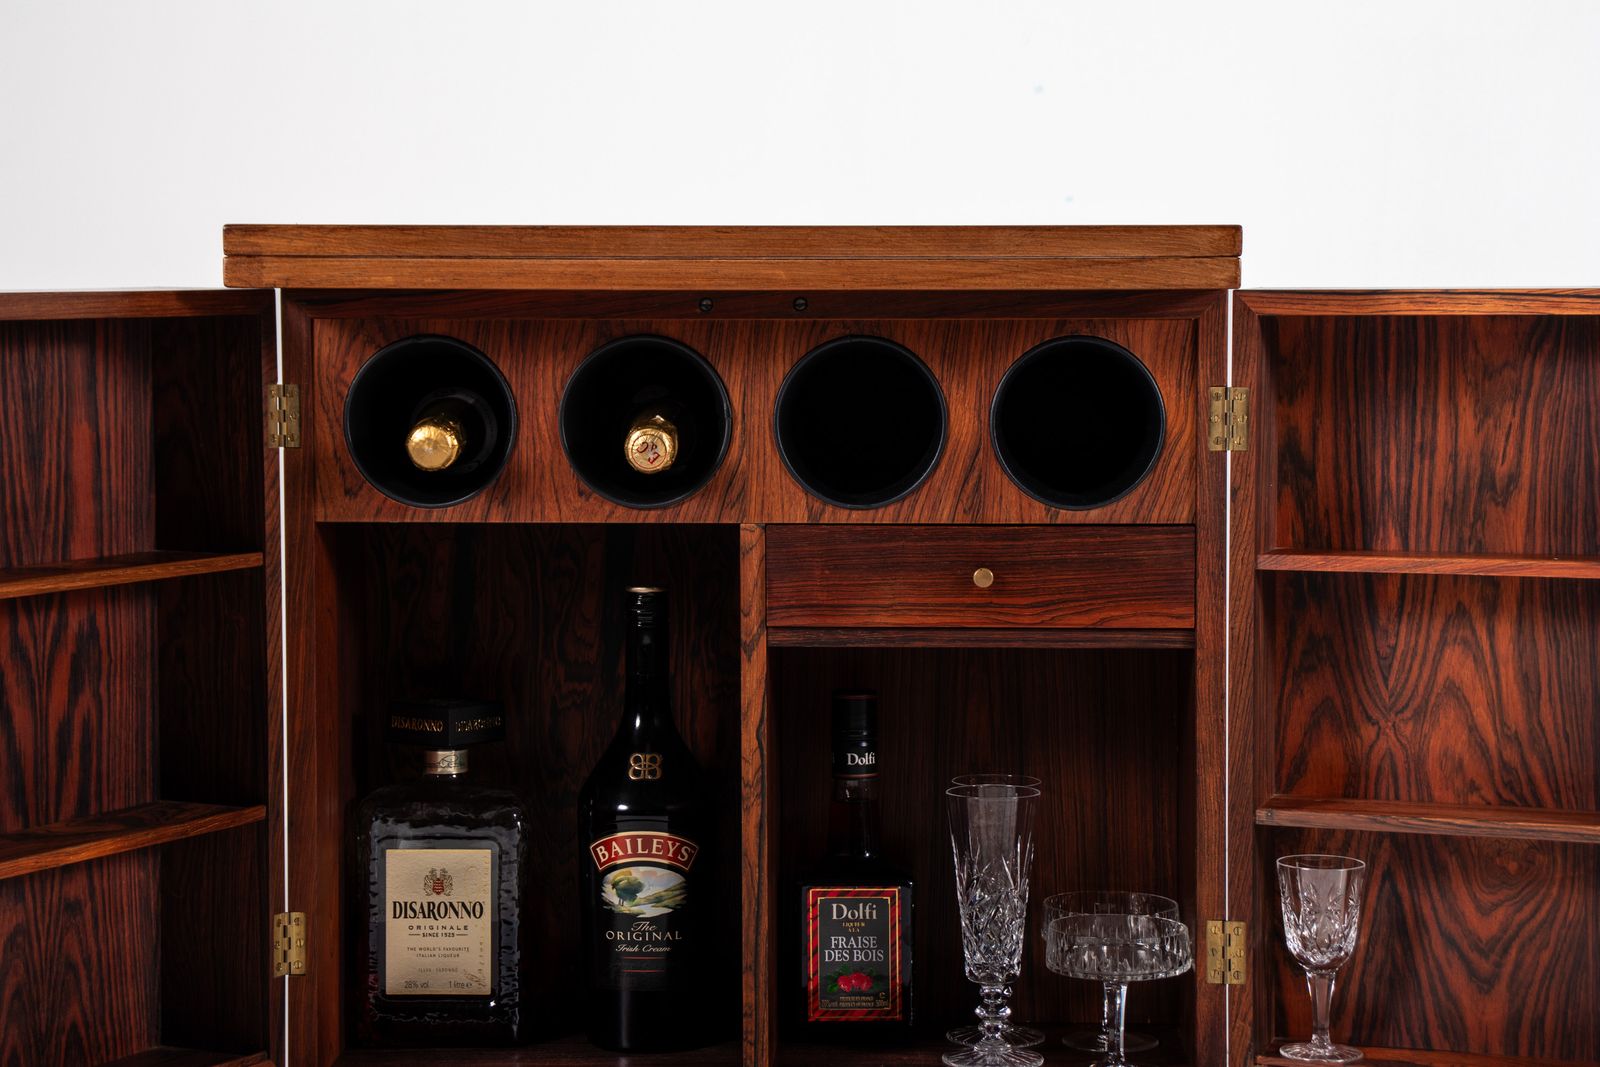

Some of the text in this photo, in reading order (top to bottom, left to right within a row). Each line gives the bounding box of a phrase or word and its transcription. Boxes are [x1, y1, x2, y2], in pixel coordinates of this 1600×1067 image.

[391, 715, 444, 732] DISARONNO
[846, 752, 876, 766] Dolfi
[596, 838, 691, 863] BAILEYS
[392, 901, 484, 920] DISARONNO
[832, 903, 877, 920] Dolfi
[631, 921, 657, 931] The
[605, 930, 683, 941] ORIGINAL
[830, 936, 877, 948] FRAISE
[615, 944, 672, 952] Irish Cream
[824, 950, 884, 962] DES BOIS
